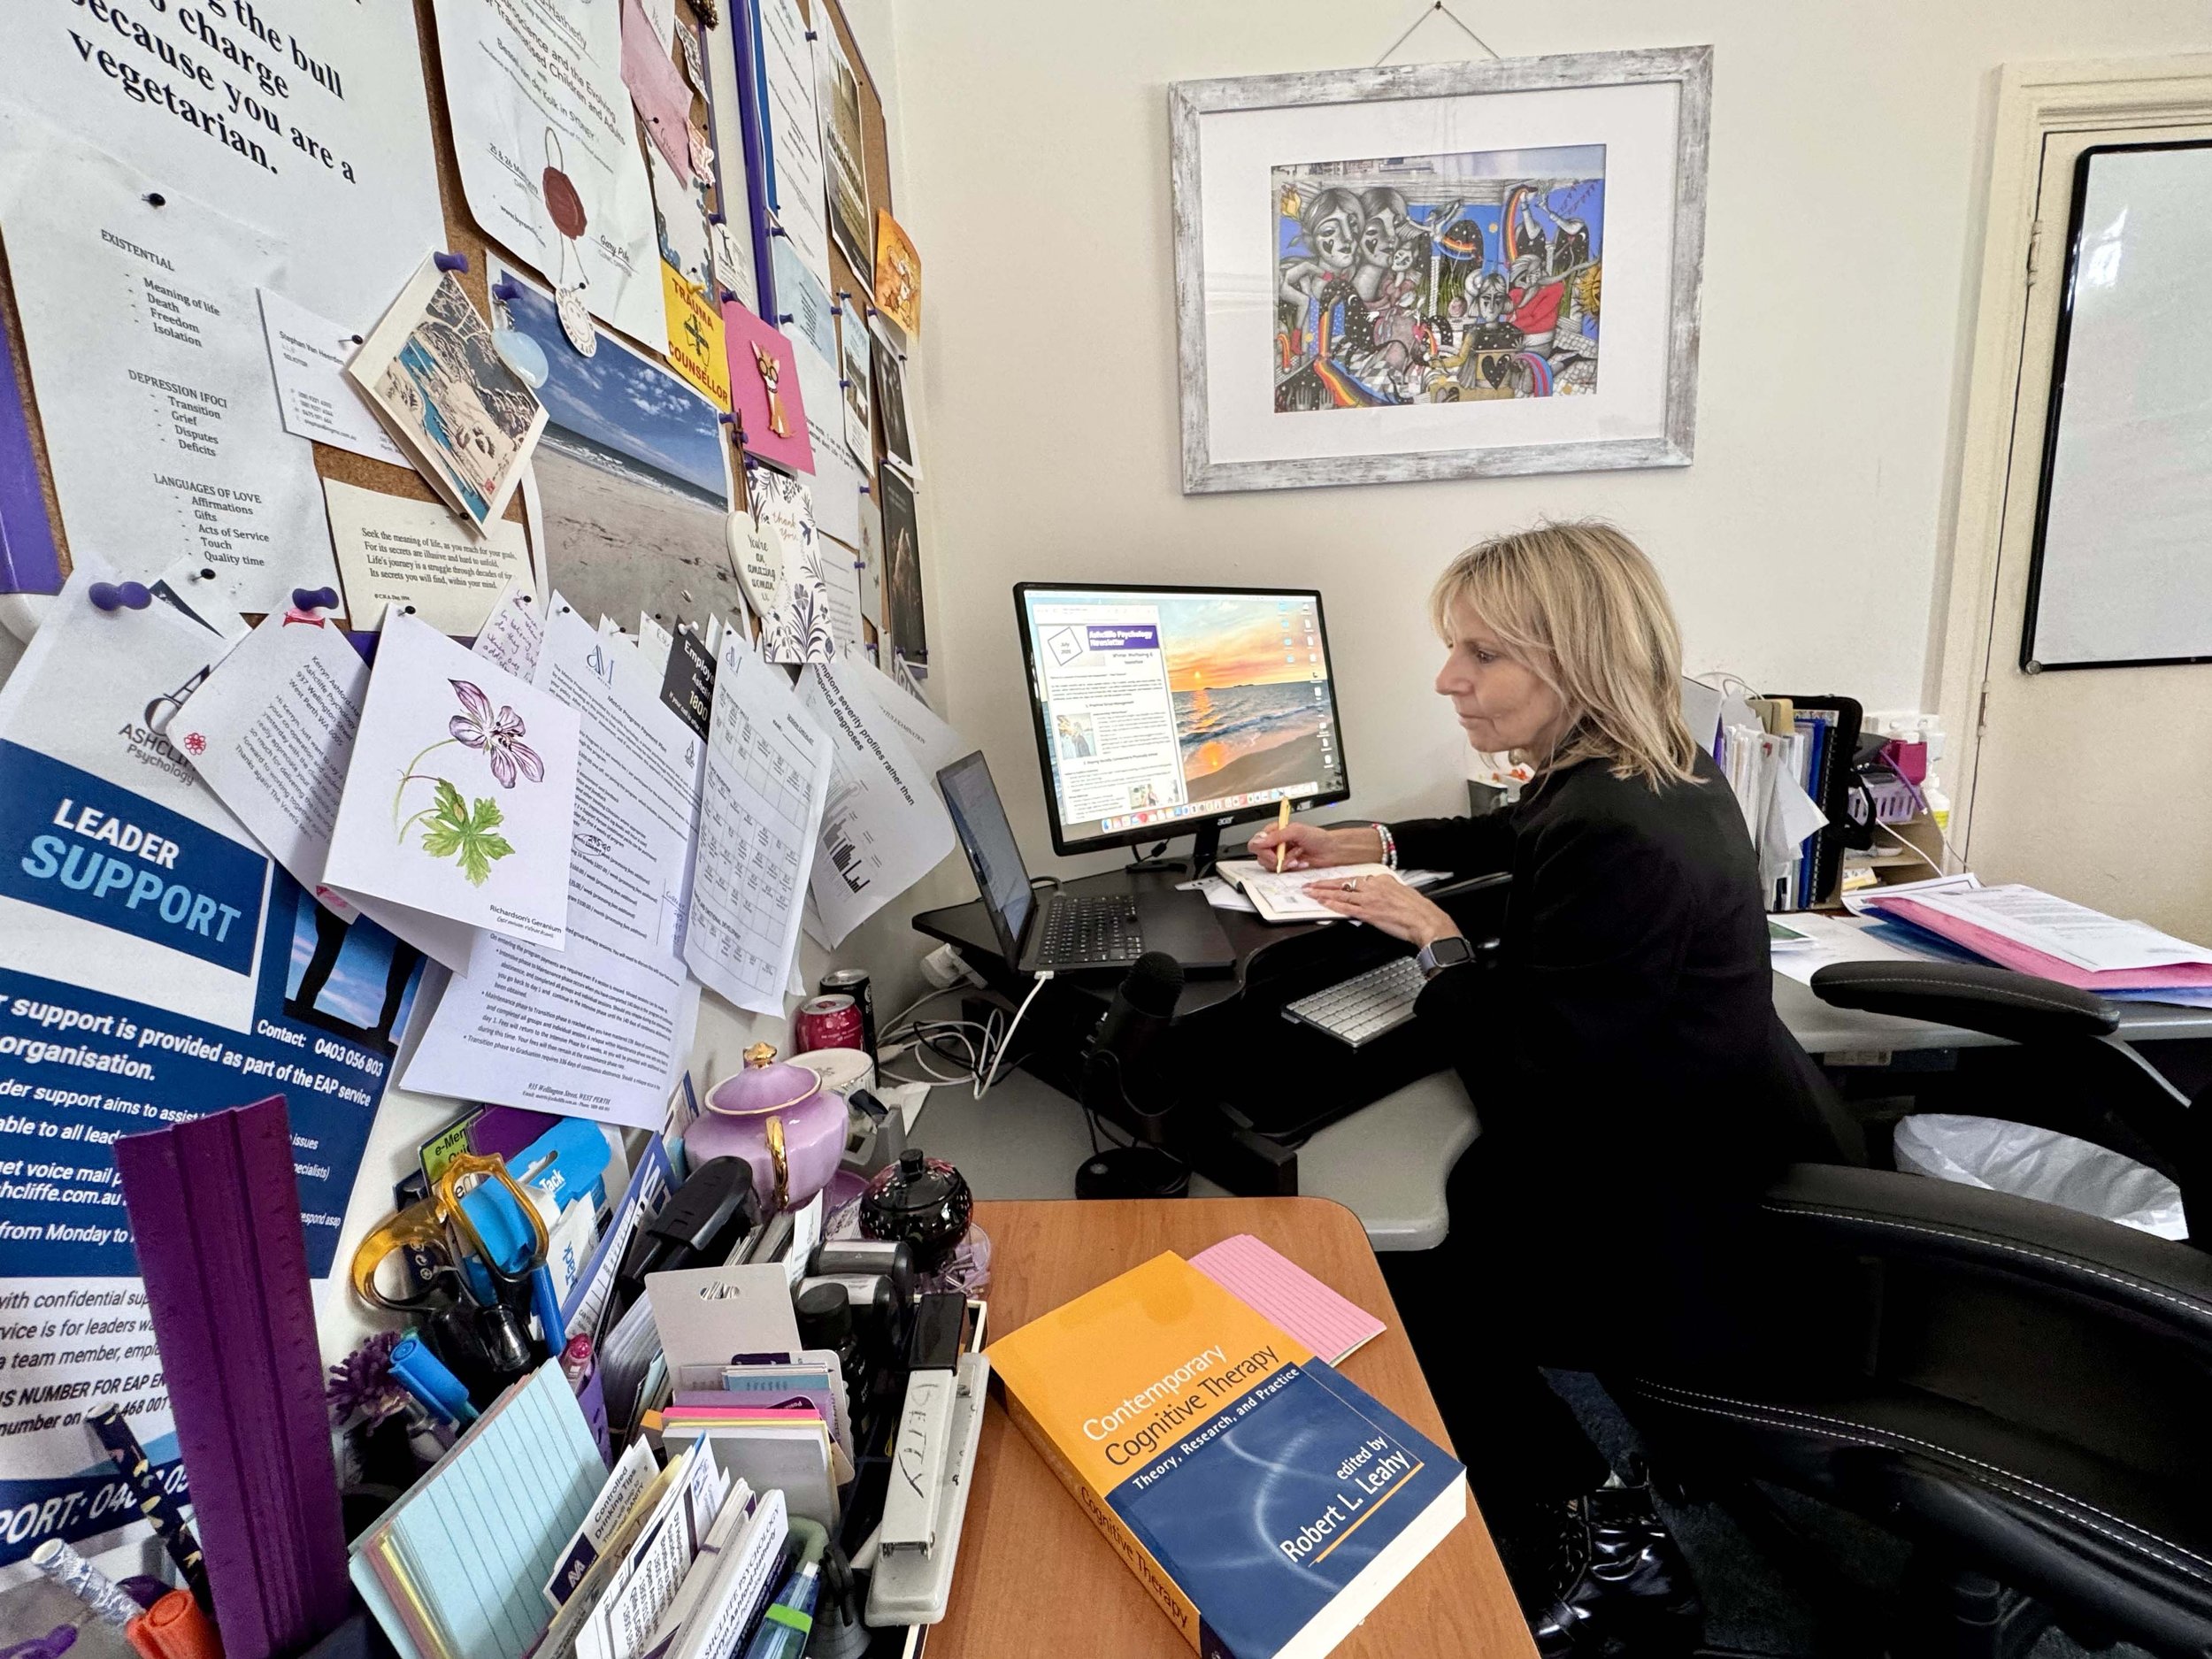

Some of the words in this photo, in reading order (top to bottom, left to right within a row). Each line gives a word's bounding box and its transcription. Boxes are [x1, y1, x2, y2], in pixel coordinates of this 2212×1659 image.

[179, 8, 288, 99] charge
[235, 0, 281, 52] the
[288, 35, 345, 101] bull
[552, 50, 568, 71] and
[571, 66, 584, 87] the
[66, 28, 278, 173] vegetarian.
[72, 0, 215, 91] ecause
[223, 81, 282, 136] you
[291, 127, 334, 168] are
[342, 161, 356, 184] a
[101, 229, 174, 272] EXISTENTIAL
[143, 278, 190, 307] Meaning
[193, 300, 202, 310] of
[204, 302, 219, 316] life
[147, 293, 180, 313] Death
[672, 278, 713, 331] TRAUMA
[150, 307, 200, 334] Freedom
[154, 323, 202, 347] Isolation
[128, 369, 197, 400] DEPRESSION
[668, 341, 727, 404] COUNSELLOR
[168, 396, 221, 419] Transition
[172, 411, 196, 426] Grief
[175, 425, 219, 444] Disputes
[179, 440, 216, 457] Deficits
[153, 473, 215, 495] LANGUAGES
[218, 488, 230, 498] OF
[233, 491, 261, 503] LOVE
[192, 496, 254, 515] Affirmations
[195, 510, 217, 521] Gifts
[772, 512, 795, 528] thank
[198, 524, 219, 536] Acts
[221, 528, 231, 537] of
[233, 529, 269, 542] Service
[201, 537, 232, 549] Touch
[362, 527, 380, 539] Seek
[381, 532, 392, 541] the
[394, 535, 421, 547] meaning
[204, 551, 240, 565] Quality
[242, 557, 265, 566] time
[365, 541, 377, 551] For
[379, 543, 388, 552] its
[389, 547, 411, 556] secrets
[367, 555, 387, 565] Life's
[388, 558, 413, 571] journey
[756, 553, 764, 563] an
[370, 568, 379, 577] Its
[381, 570, 403, 580] secrets
[405, 574, 418, 583] you
[419, 573, 432, 582] will
[689, 690, 708, 721] 1800
[833, 709, 864, 751] diagnoses
[119, 723, 196, 772] ASHCLI
[235, 743, 254, 771] Thanks
[838, 695, 864, 729] severity
[858, 729, 885, 761] profiles
[882, 761, 902, 786] rather
[900, 786, 915, 806] than
[127, 744, 195, 786] Psychology
[52, 798, 180, 870] LEADER
[1217, 816, 1234, 826] acer
[21, 834, 242, 943] SUPPORT
[490, 904, 531, 924] Richardson's
[531, 918, 562, 933] Geranium
[0, 1035, 156, 1081] organisation.
[11, 998, 115, 1035] support
[115, 1017, 138, 1041] is
[137, 1028, 223, 1062] provided
[224, 1052, 242, 1068] as
[242, 1056, 275, 1078] part
[276, 1064, 292, 1080] of
[292, 1069, 313, 1087] the
[314, 1074, 339, 1094] EAP
[339, 1085, 371, 1106] service
[257, 1019, 307, 1048] Contact:
[314, 1039, 347, 1063] 0403
[346, 1053, 365, 1070] 056
[365, 1057, 384, 1078] 803
[34, 1087, 102, 1108] support
[104, 1097, 141, 1115] aims
[143, 1103, 157, 1118] to
[38, 1121, 58, 1137] to
[60, 1124, 84, 1140] all
[293, 1133, 319, 1149] issues
[27, 1163, 73, 1179] voice
[76, 1168, 113, 1184] mail
[539, 1169, 565, 1191] Tack
[0, 1180, 122, 1206] hcliffe.com.au
[0, 1221, 42, 1240] from
[45, 1224, 111, 1247] Monday
[113, 1227, 128, 1242] to
[326, 1216, 342, 1228] asap
[34, 1289, 127, 1309] confidential
[41, 1321, 55, 1338] is
[60, 1319, 84, 1337] for
[86, 1317, 135, 1335] leaders
[12, 1352, 55, 1369] team
[58, 1345, 121, 1365] member,
[19, 1381, 91, 1406] NUMBER
[92, 1379, 121, 1396] FOR
[122, 1374, 150, 1392] EAP
[1082, 1344, 1228, 1442] Contemporary
[63, 1412, 81, 1426] on
[145, 1396, 169, 1413] 001
[1105, 1394, 1207, 1466] Cognitive
[1197, 1345, 1279, 1397] Therapy
[1133, 1455, 1182, 1491] Theory,
[1180, 1416, 1238, 1455] Research,
[1236, 1397, 1257, 1417] and
[1256, 1368, 1300, 1401] Practice
[1337, 1447, 1372, 1480] edited
[1366, 1436, 1387, 1450] by
[595, 1466, 628, 1524] Controlled
[595, 1492, 624, 1540] Drinking
[622, 1469, 636, 1490] Tips
[626, 1482, 643, 1515] SANITY
[1279, 1505, 1346, 1563] Robert
[1337, 1494, 1363, 1511] L.
[1355, 1451, 1410, 1494] Leahy
[739, 1505, 779, 1589] PSYCHOLOGY
[1081, 1486, 1133, 1562] Cognitive
[1137, 1552, 1187, 1628] Therapy
